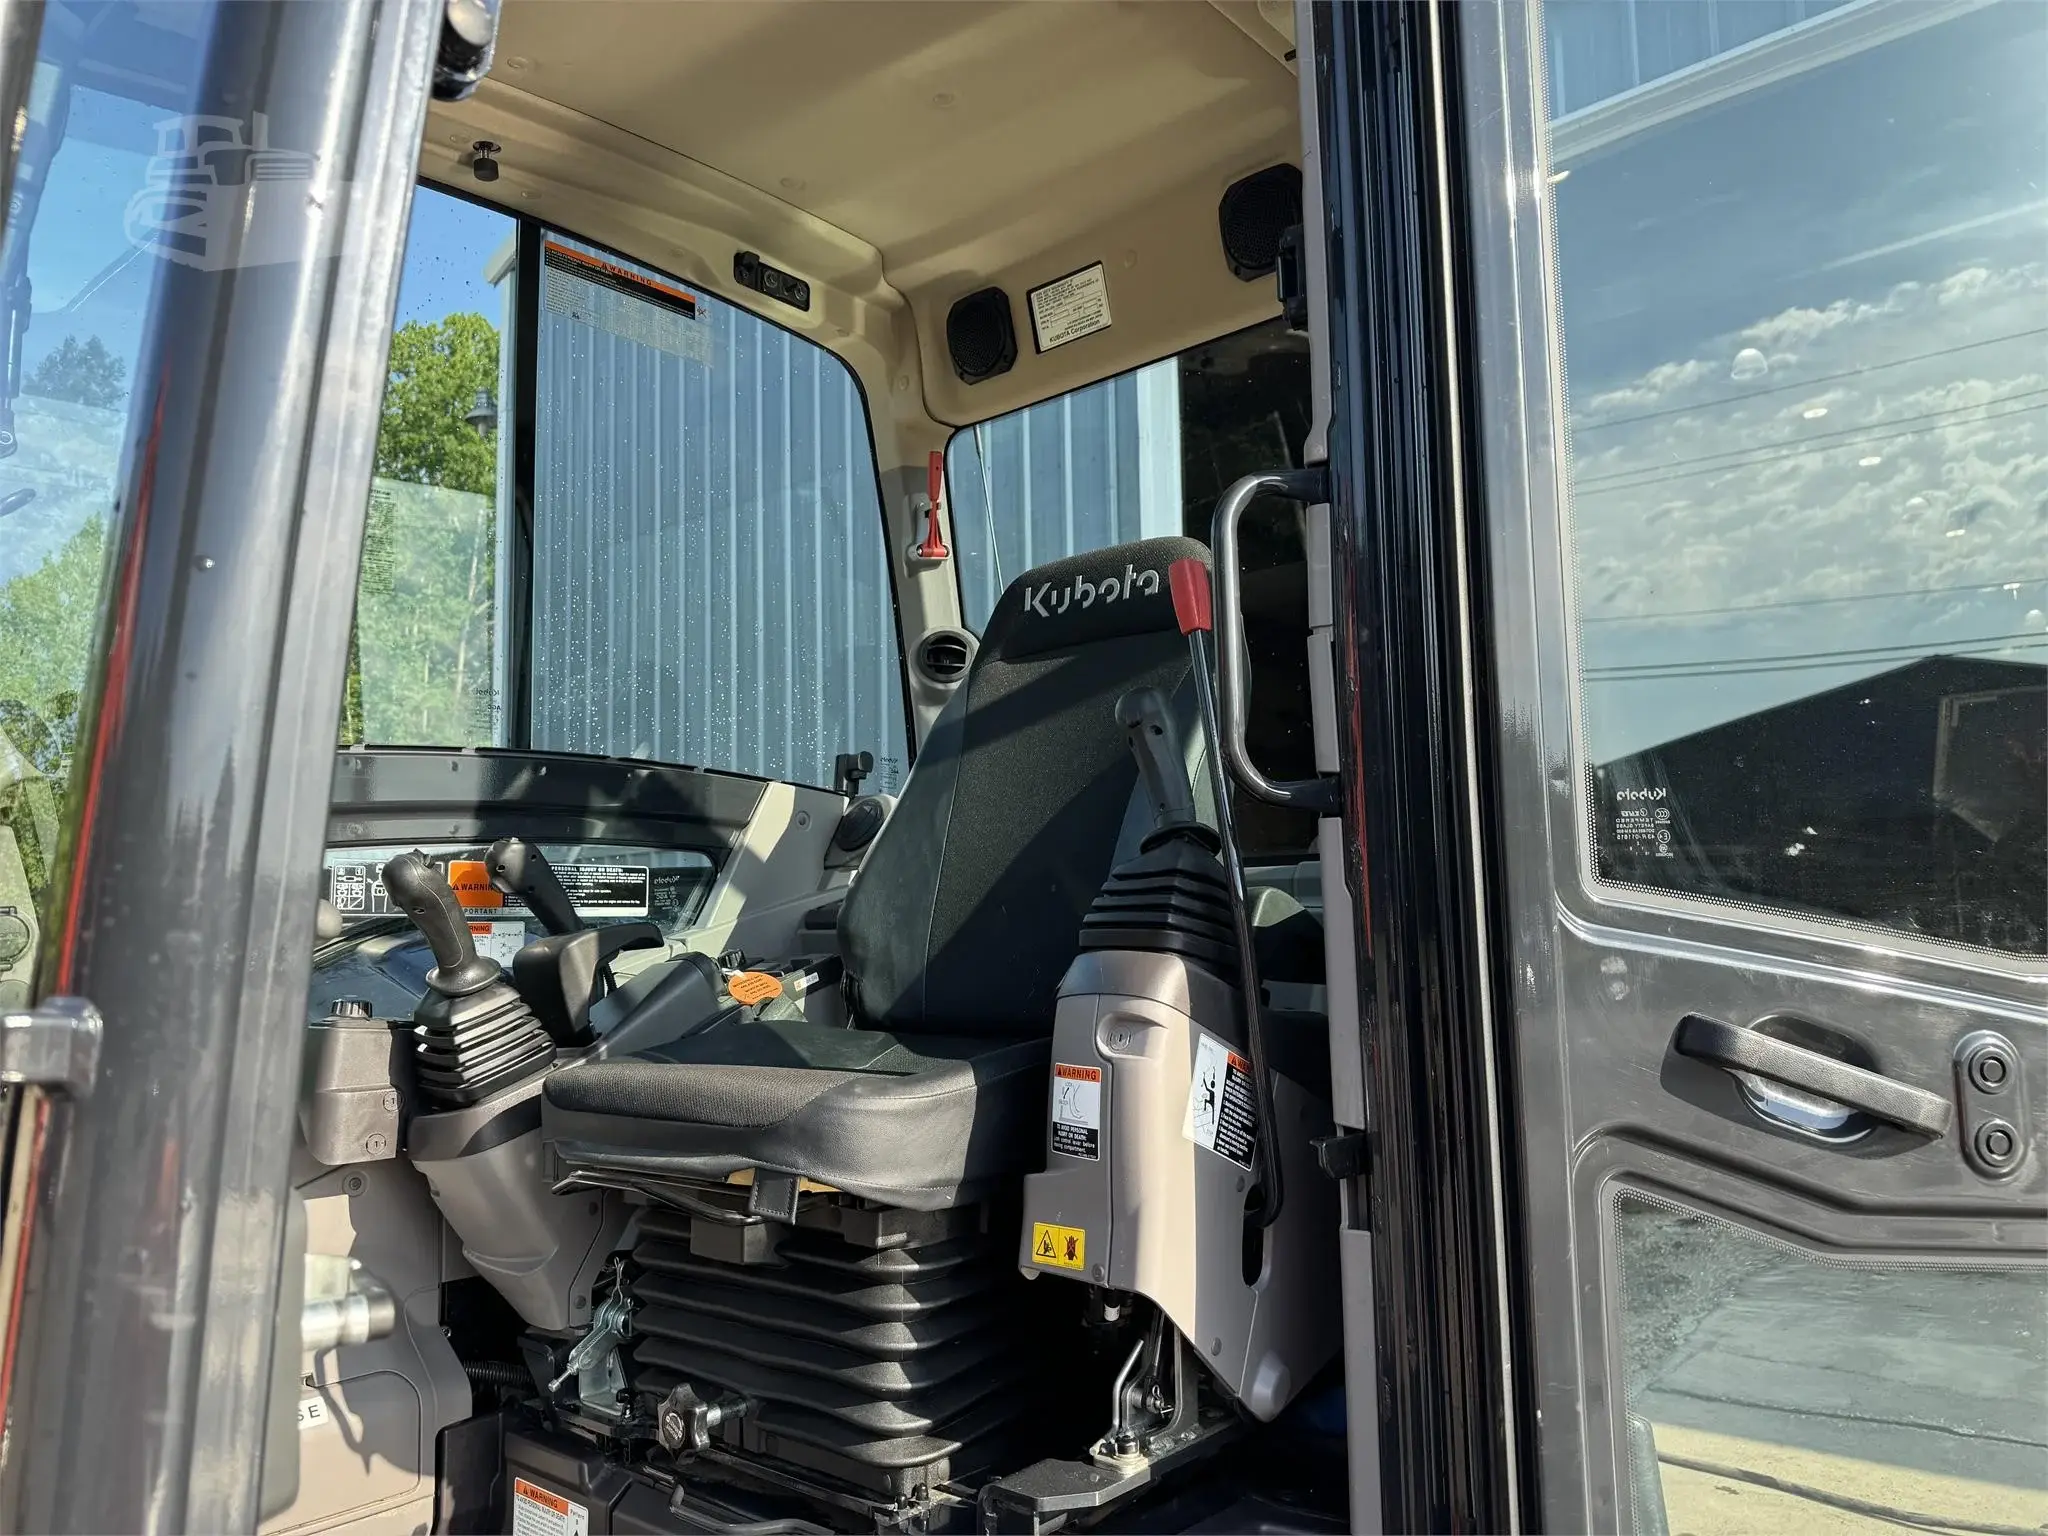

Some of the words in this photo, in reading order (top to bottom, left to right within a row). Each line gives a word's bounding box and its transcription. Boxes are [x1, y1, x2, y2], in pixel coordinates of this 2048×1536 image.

[608, 264, 652, 286] WARNING
[1049, 330, 1071, 343] KUBOTA
[1070, 319, 1101, 335] Corporation
[1024, 563, 1160, 618] Kubota
[461, 883, 495, 892] WARNIN
[1062, 1067, 1097, 1081] WARNING
[529, 1487, 558, 1509] WARNING
